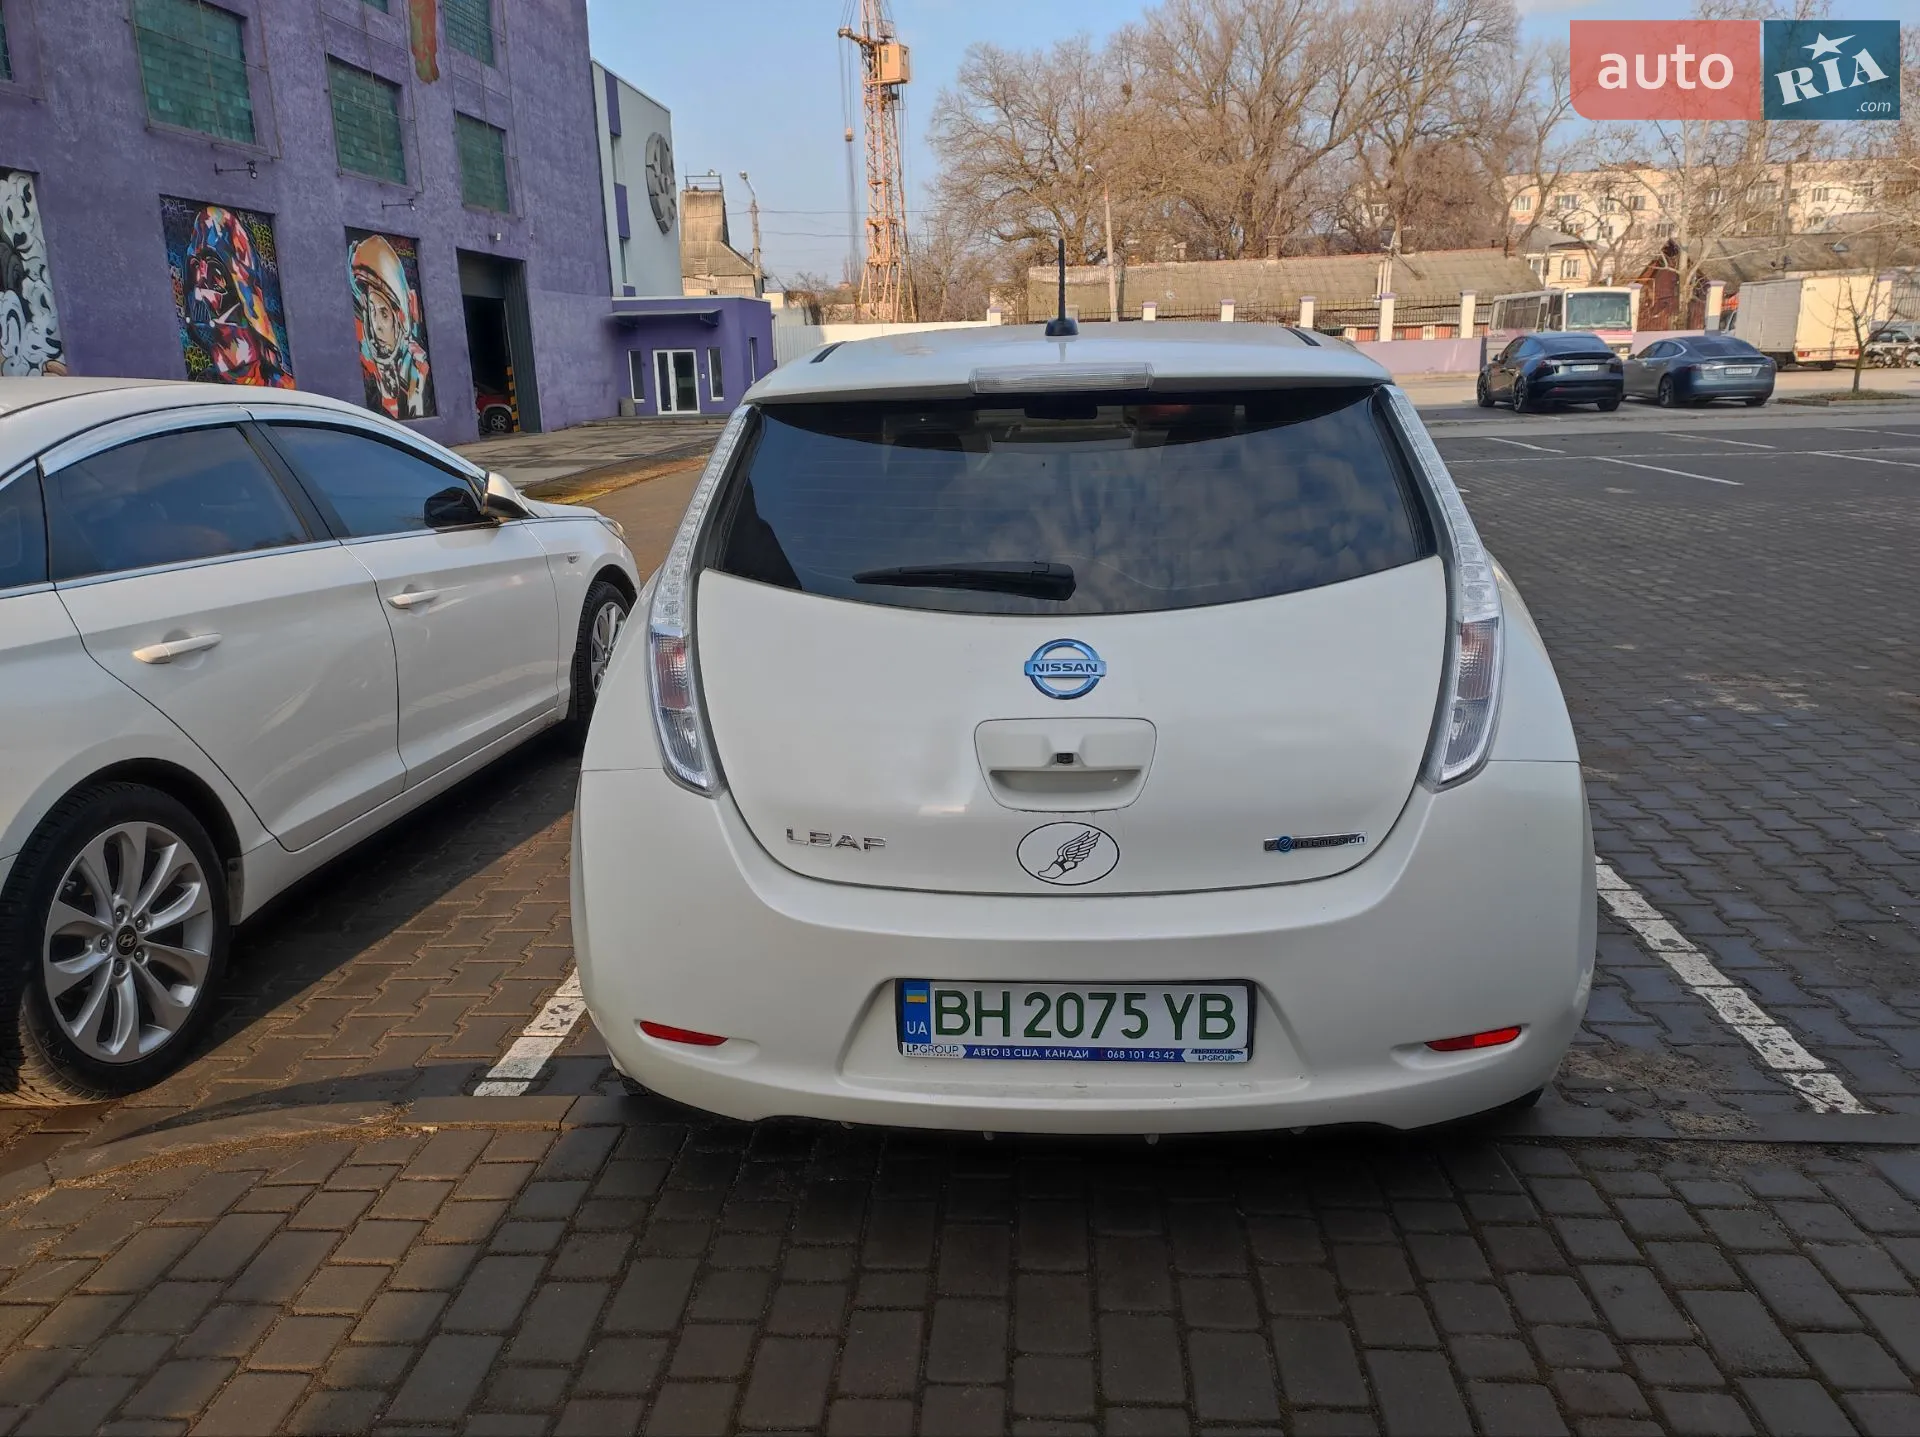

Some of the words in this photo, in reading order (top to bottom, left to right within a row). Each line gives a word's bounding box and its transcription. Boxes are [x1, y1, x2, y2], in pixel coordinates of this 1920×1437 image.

[1032, 663, 1098, 673] NISSAN
[786, 828, 887, 852] LEAF
[934, 989, 1011, 1037] BH
[1023, 991, 1149, 1039] 2075
[1163, 993, 1236, 1041] YB
[906, 1021, 928, 1035] UA
[972, 1048, 1000, 1057] АВТО
[1045, 1050, 1089, 1059] КАНАДИ
[1107, 1050, 1125, 1059] 068
[1129, 1051, 1145, 1060] 101
[1148, 1051, 1161, 1060] 43
[1163, 1051, 1175, 1060] 42
